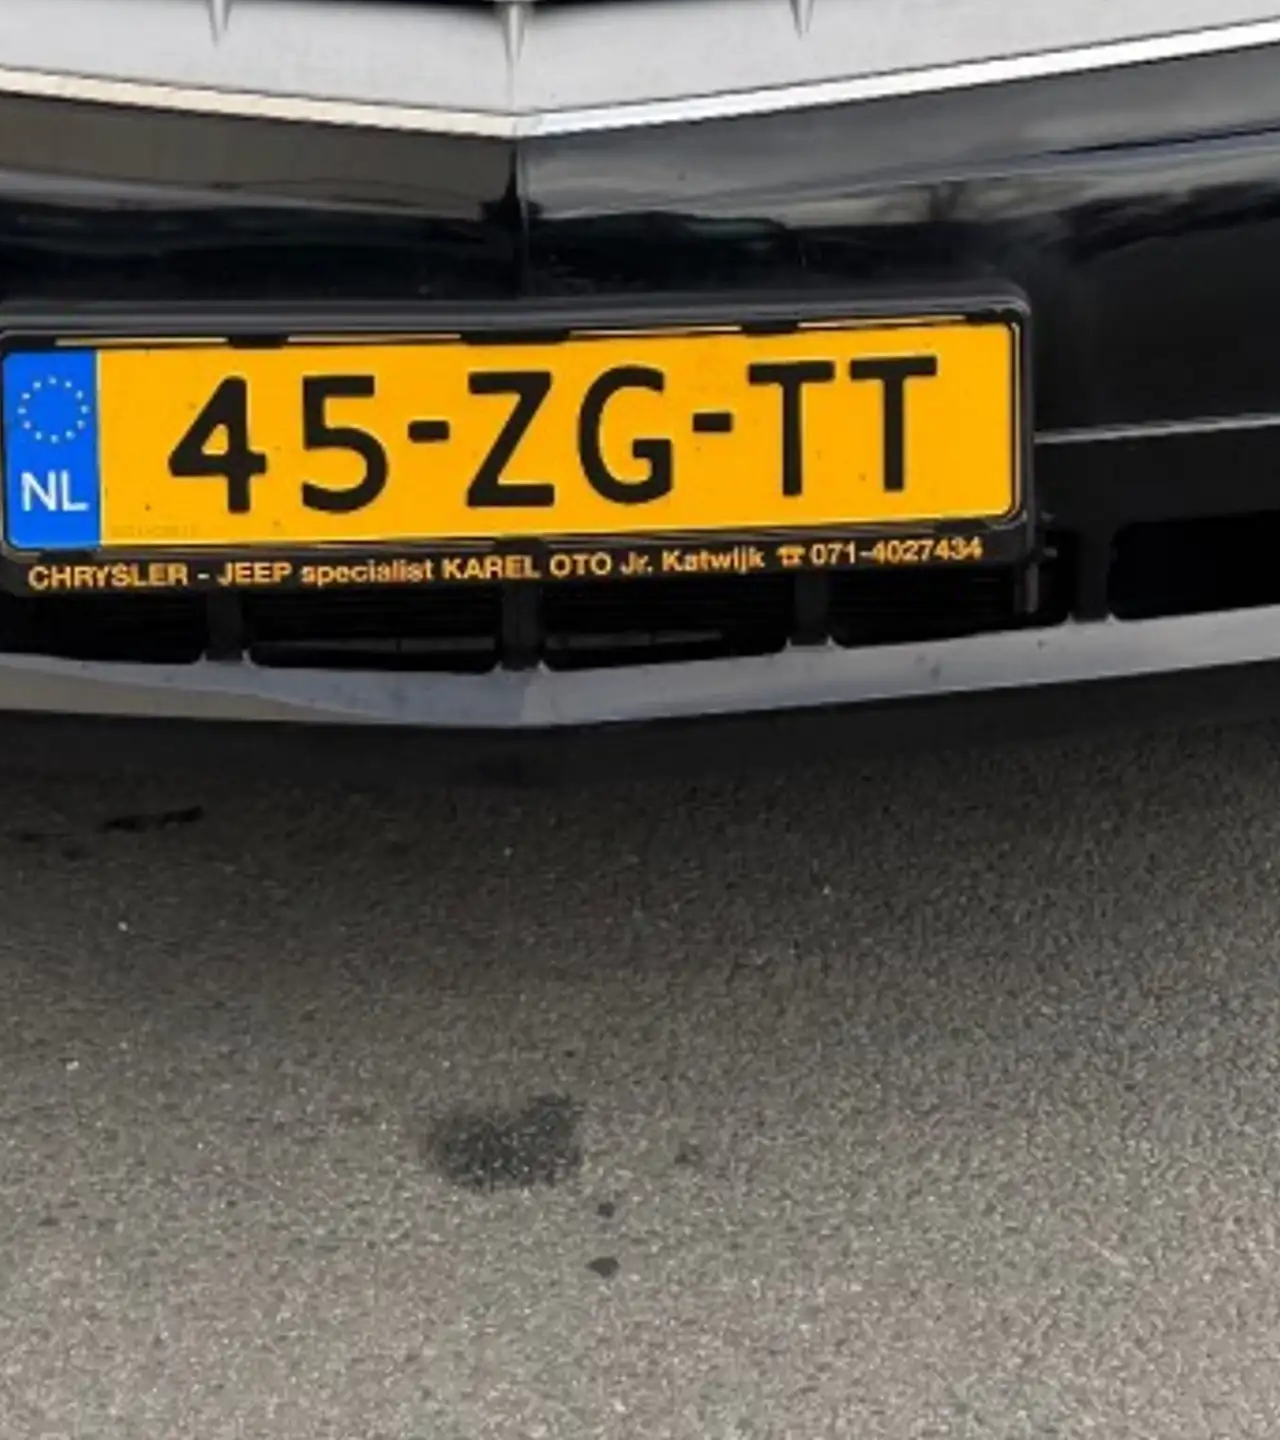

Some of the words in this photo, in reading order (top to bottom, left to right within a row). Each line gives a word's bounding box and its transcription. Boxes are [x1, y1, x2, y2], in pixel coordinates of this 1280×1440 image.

[167, 355, 939, 514] 45-ZG-TT
[20, 470, 88, 512] NL
[27, 562, 189, 590] CHRYSLER
[217, 559, 293, 587] JEEP
[300, 556, 433, 588] specialist
[441, 553, 542, 580] KAREL
[548, 550, 612, 578] OTO
[620, 550, 654, 576] Jr.
[661, 545, 766, 575] Katwijk
